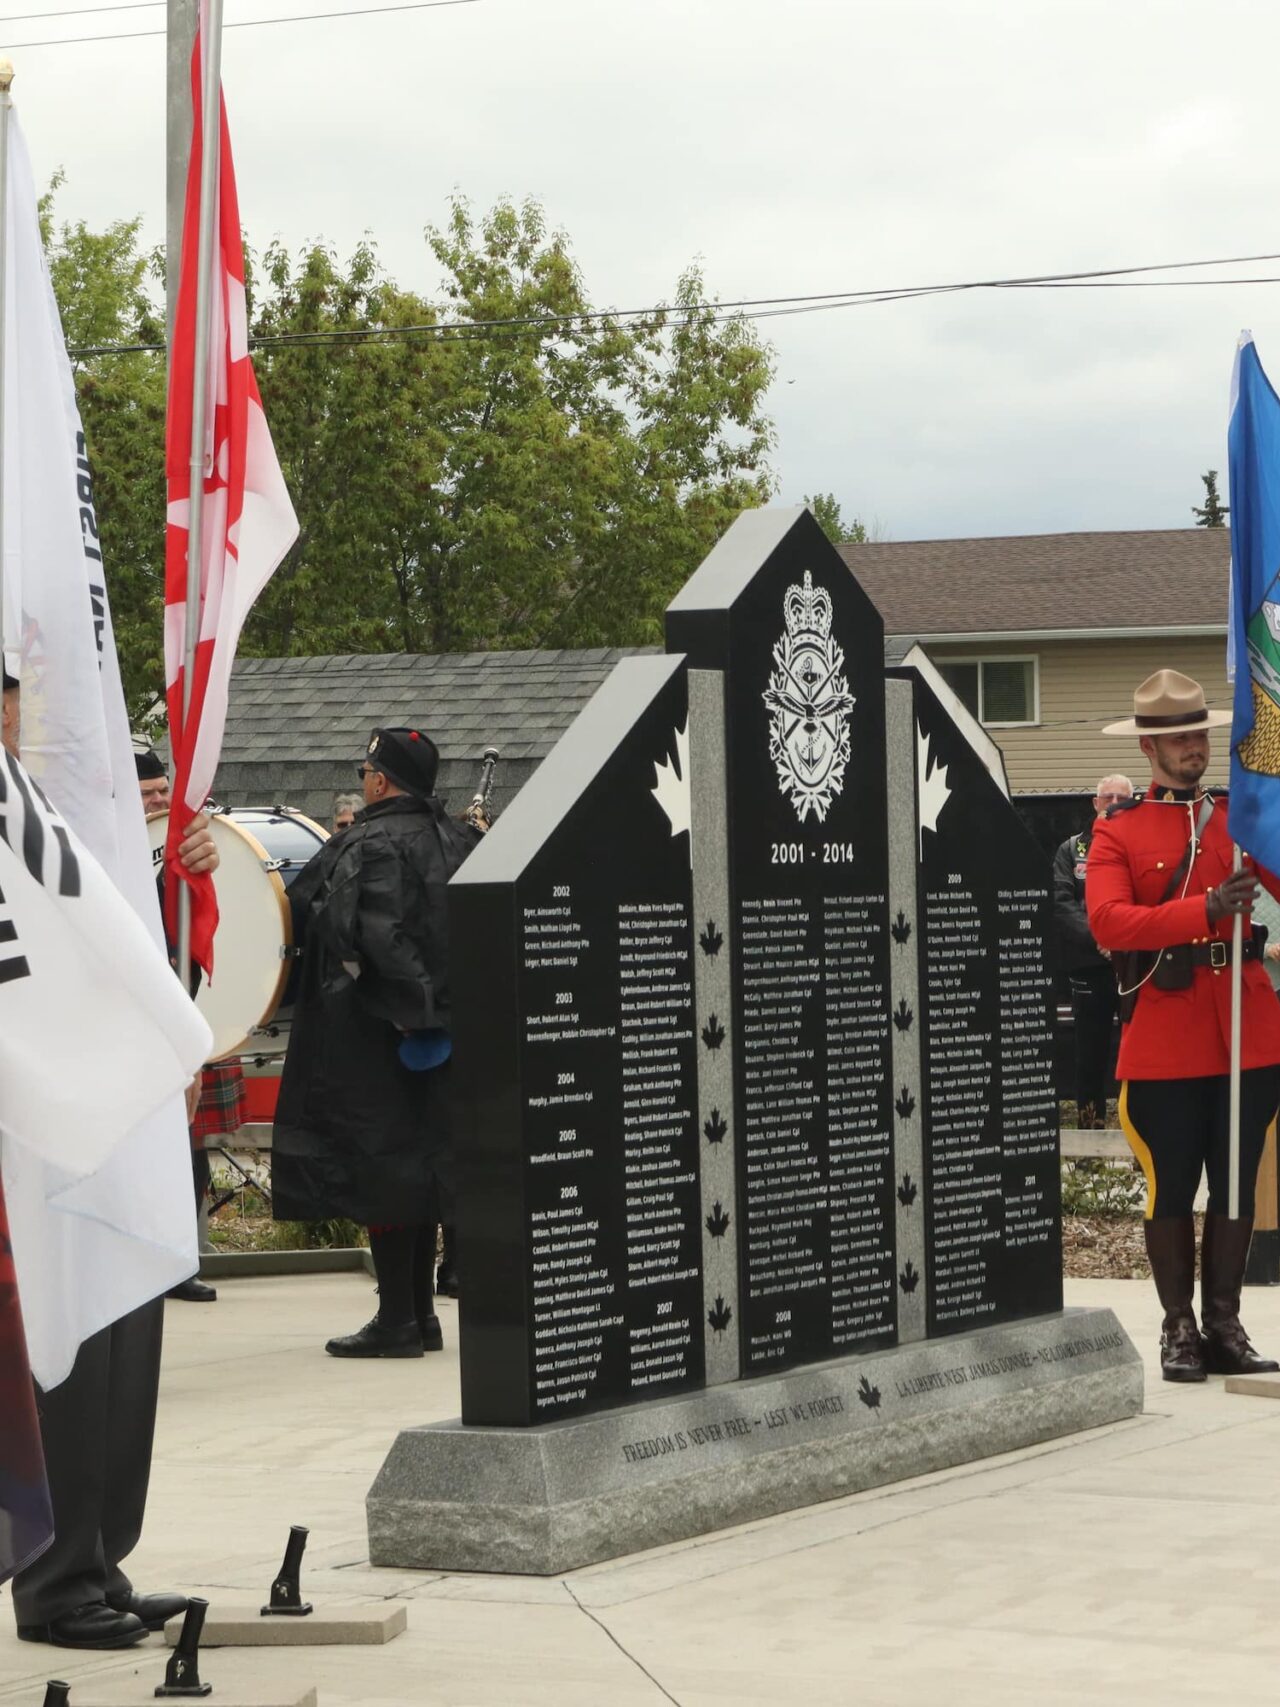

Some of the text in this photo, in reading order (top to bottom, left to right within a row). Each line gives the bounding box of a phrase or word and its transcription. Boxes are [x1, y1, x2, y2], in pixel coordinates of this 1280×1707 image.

[771, 843, 804, 863] 2001
[823, 843, 854, 863] 2014
[948, 873, 962, 884] 2009
[553, 885, 571, 897] 2002
[563, 907, 571, 916] Cpl
[555, 992, 573, 1004] 2003
[557, 1072, 575, 1085] 2004
[559, 1129, 577, 1142] 2005
[560, 1186, 578, 1199] 2006
[575, 1206, 583, 1216] Cpl
[584, 1255, 592, 1264] Cpl
[600, 1269, 608, 1278] Cpl
[657, 1301, 673, 1315] 2007
[775, 1310, 792, 1323] 2008
[594, 1336, 602, 1345] Cpl
[895, 1382, 912, 1398] LA
[969, 1360, 1000, 1381] JAMAIS
[1094, 1332, 1123, 1352] JAMAIS
[588, 1370, 596, 1380] Cpl
[622, 1435, 675, 1463] FREEDOM
[674, 1431, 688, 1450] IS
[687, 1424, 725, 1445] NEVER
[724, 1417, 752, 1438] FREE
[763, 1407, 788, 1429] LEST
[789, 1404, 809, 1421] WE
[807, 1395, 845, 1418] FORGET
